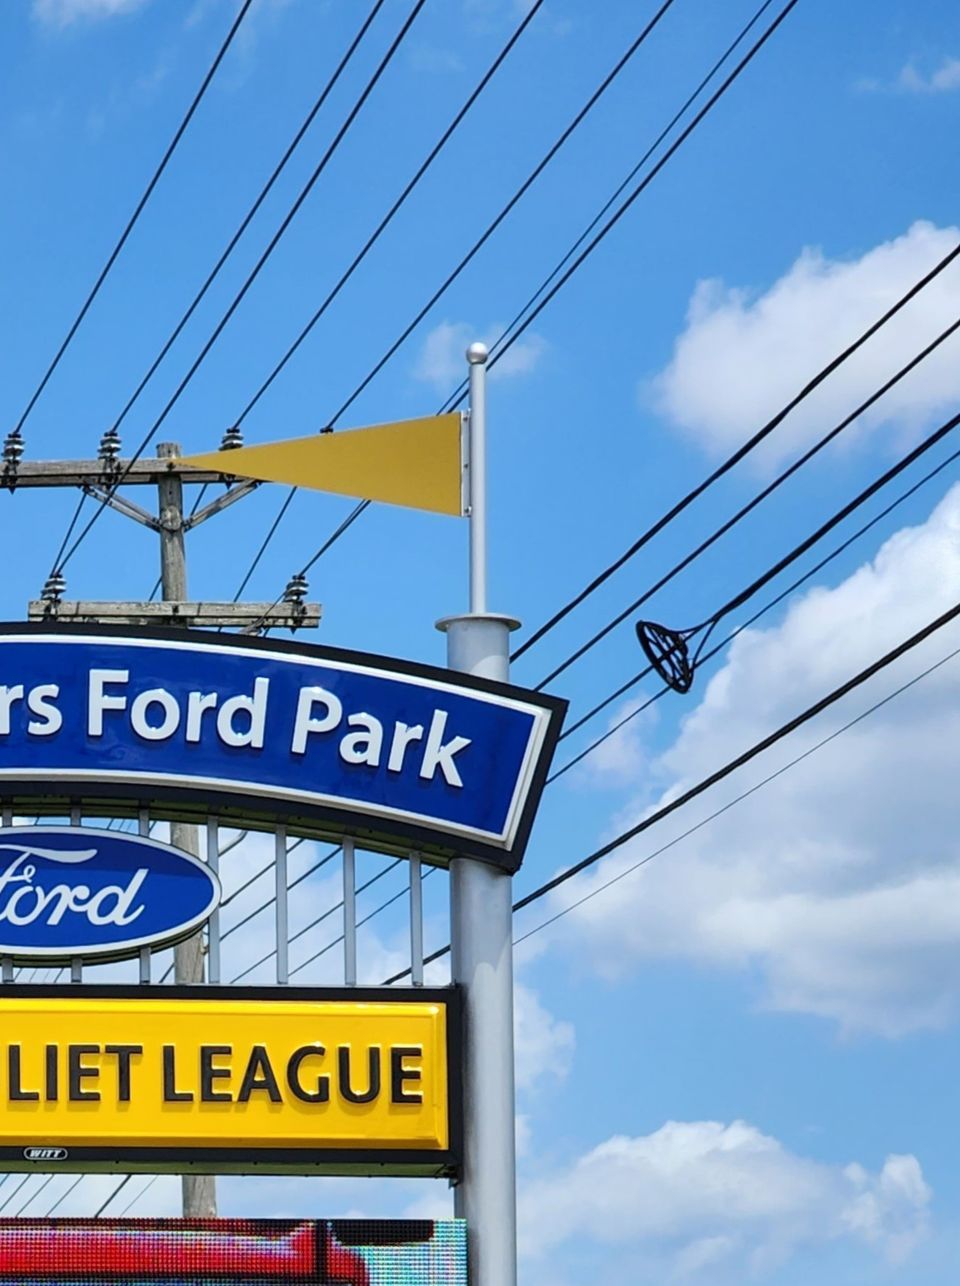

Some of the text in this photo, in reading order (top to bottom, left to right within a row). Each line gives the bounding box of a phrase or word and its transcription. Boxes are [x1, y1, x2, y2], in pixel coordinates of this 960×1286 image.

[87, 669, 270, 749] Ford
[291, 686, 471, 787] Park
[162, 1045, 423, 1104] LEAGUE
[29, 1149, 62, 1158] WITT
